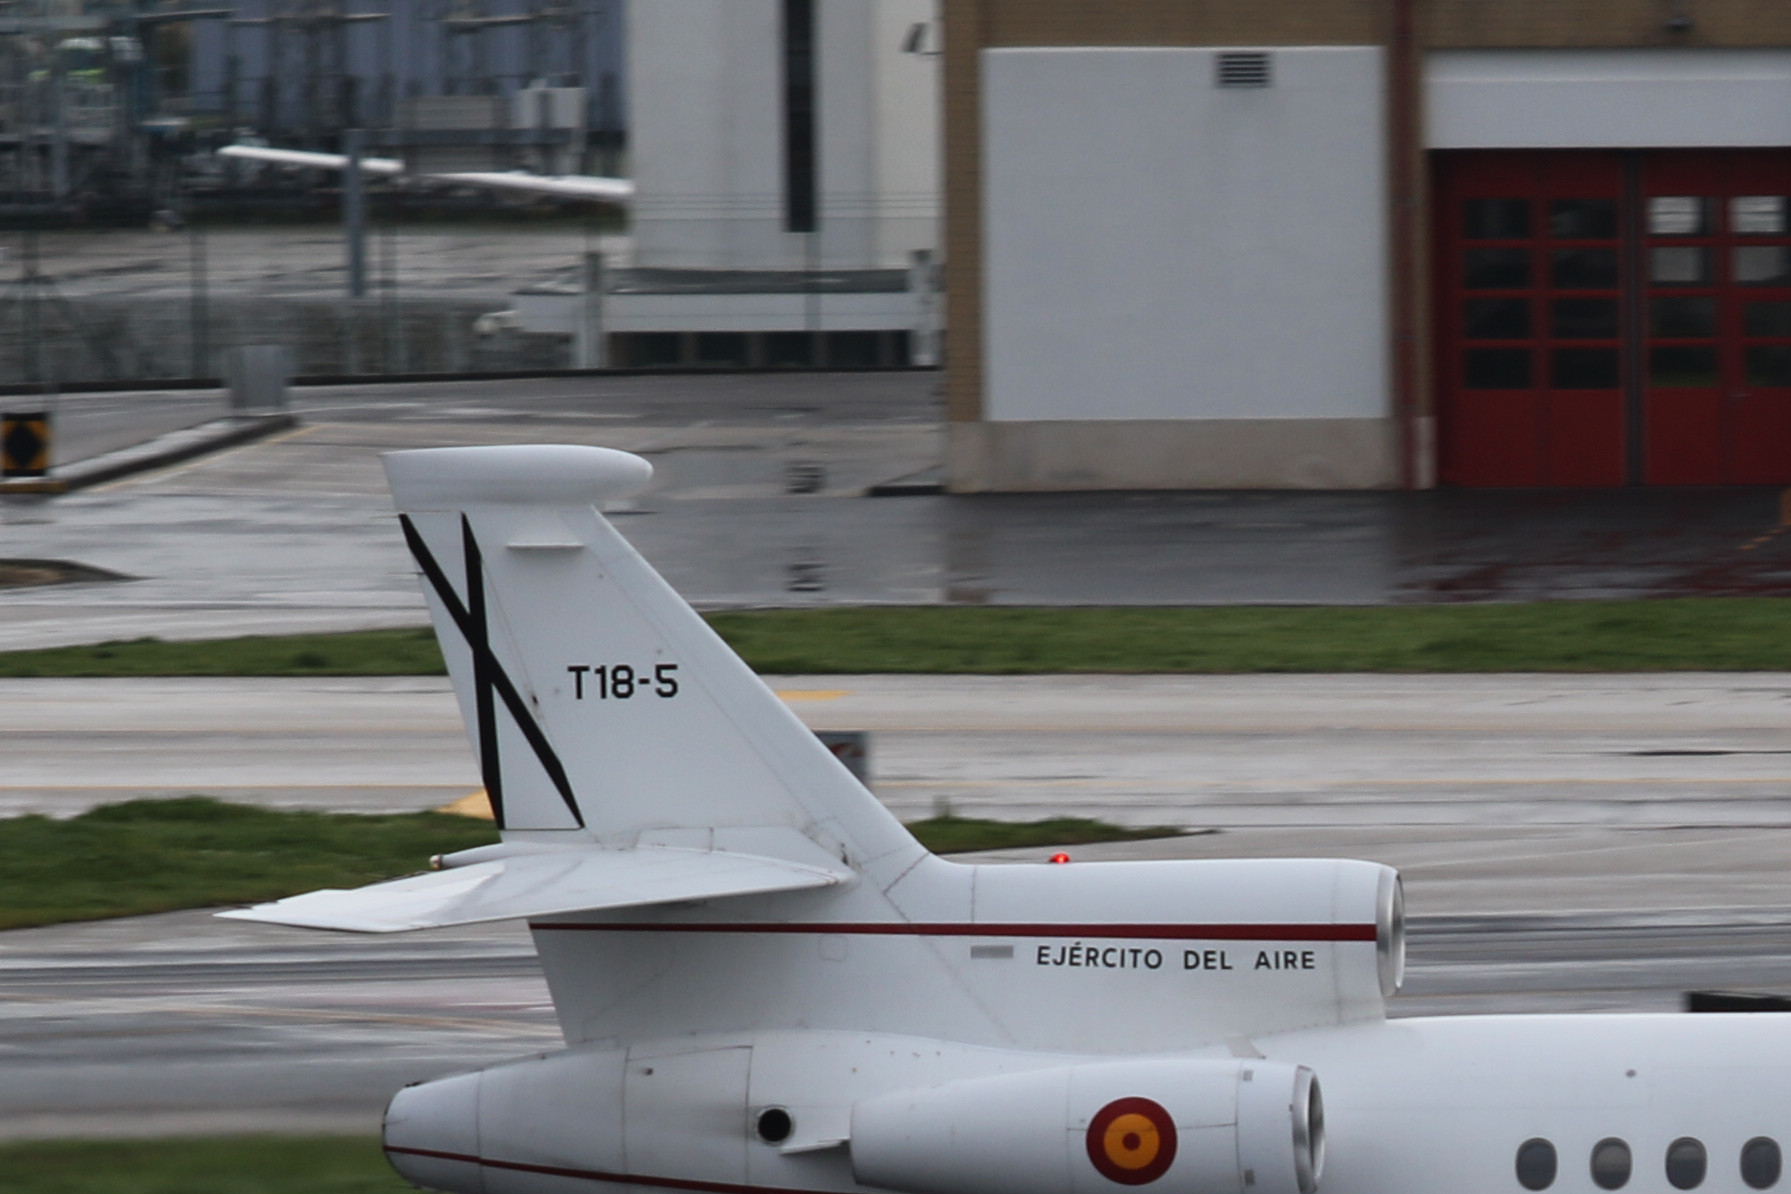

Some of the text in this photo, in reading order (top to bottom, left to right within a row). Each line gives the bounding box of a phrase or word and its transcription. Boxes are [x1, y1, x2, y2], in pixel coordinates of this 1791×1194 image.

[566, 663, 680, 700] T18-5
[1035, 941, 1316, 971] EJÉRCITO DEL AIRE
